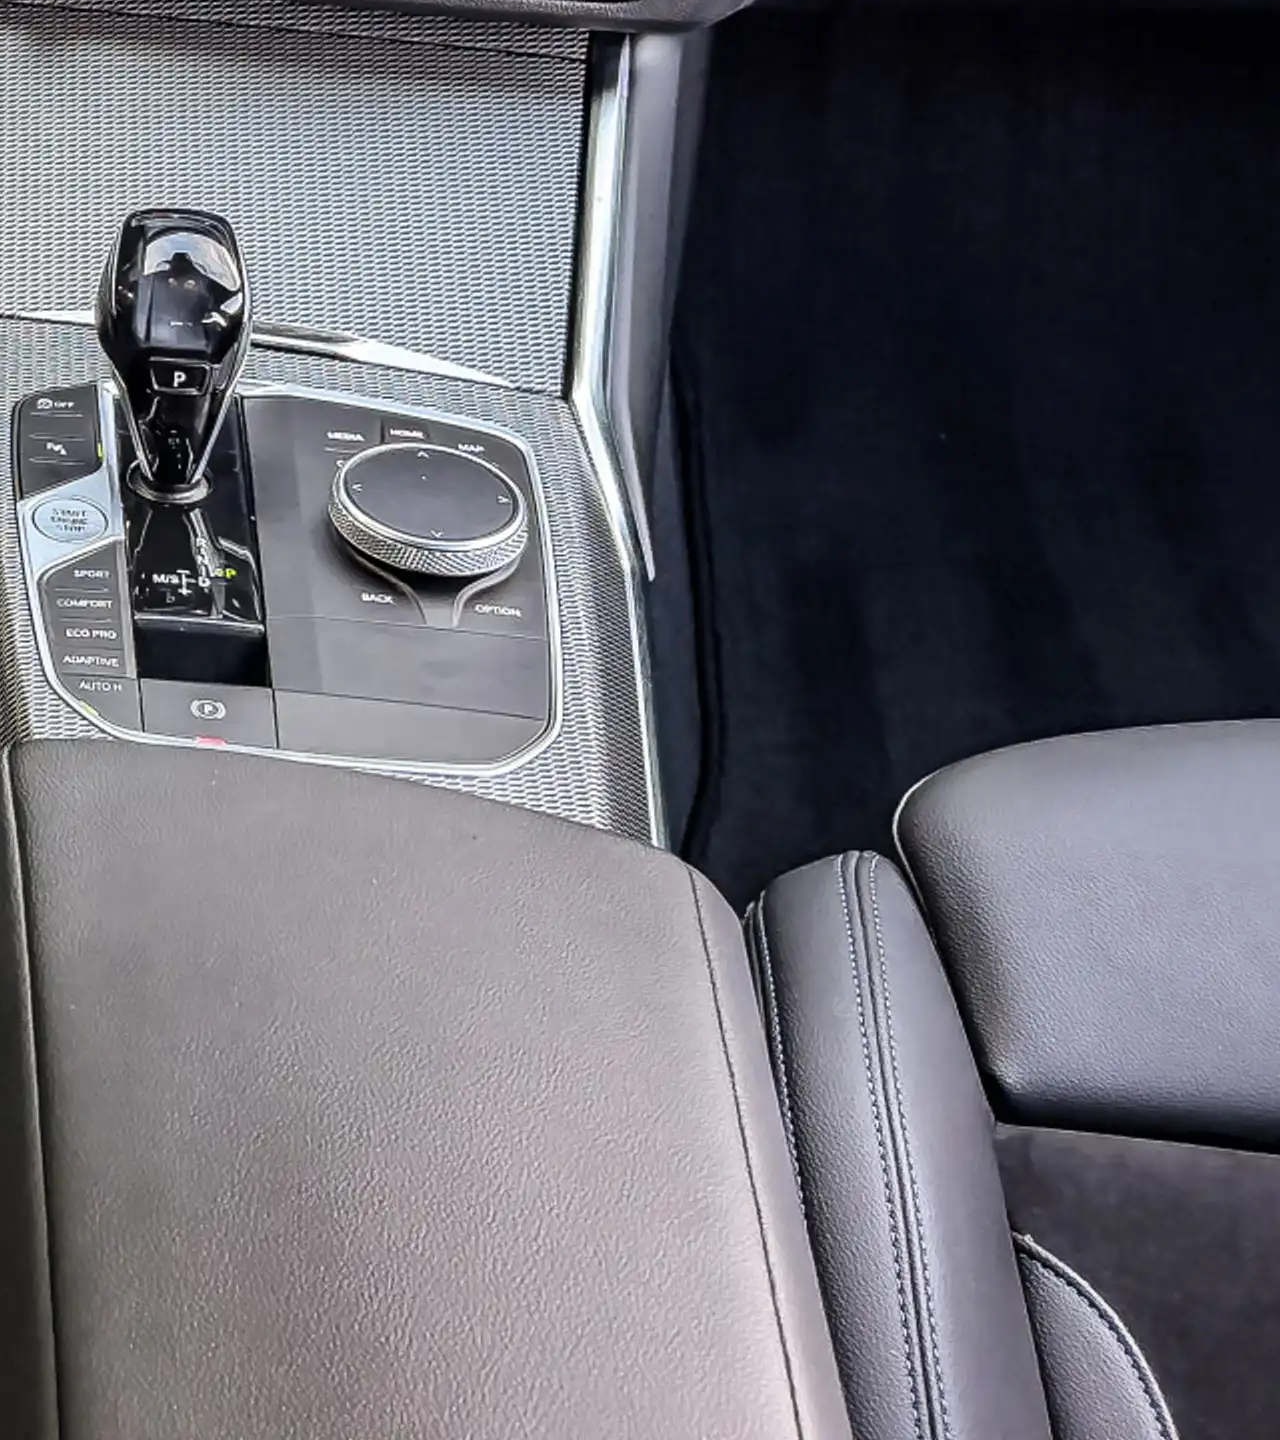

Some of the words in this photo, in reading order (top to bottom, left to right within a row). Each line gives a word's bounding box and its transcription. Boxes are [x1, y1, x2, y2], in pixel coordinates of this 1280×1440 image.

[173, 371, 187, 388] P
[54, 401, 75, 409] OFF
[326, 431, 365, 442] MEDIA
[390, 428, 425, 439] HOME
[458, 443, 485, 453] MAP
[73, 569, 110, 579] SPORT
[152, 573, 180, 584] M/S
[56, 598, 113, 609] COMFORT
[361, 592, 395, 604] BACK
[474, 604, 522, 618] OPTION
[66, 627, 90, 638] ECO
[92, 629, 117, 640] PRO
[63, 655, 120, 667] ADAPTIVE
[80, 680, 111, 692] AUTO
[113, 682, 122, 692] H
